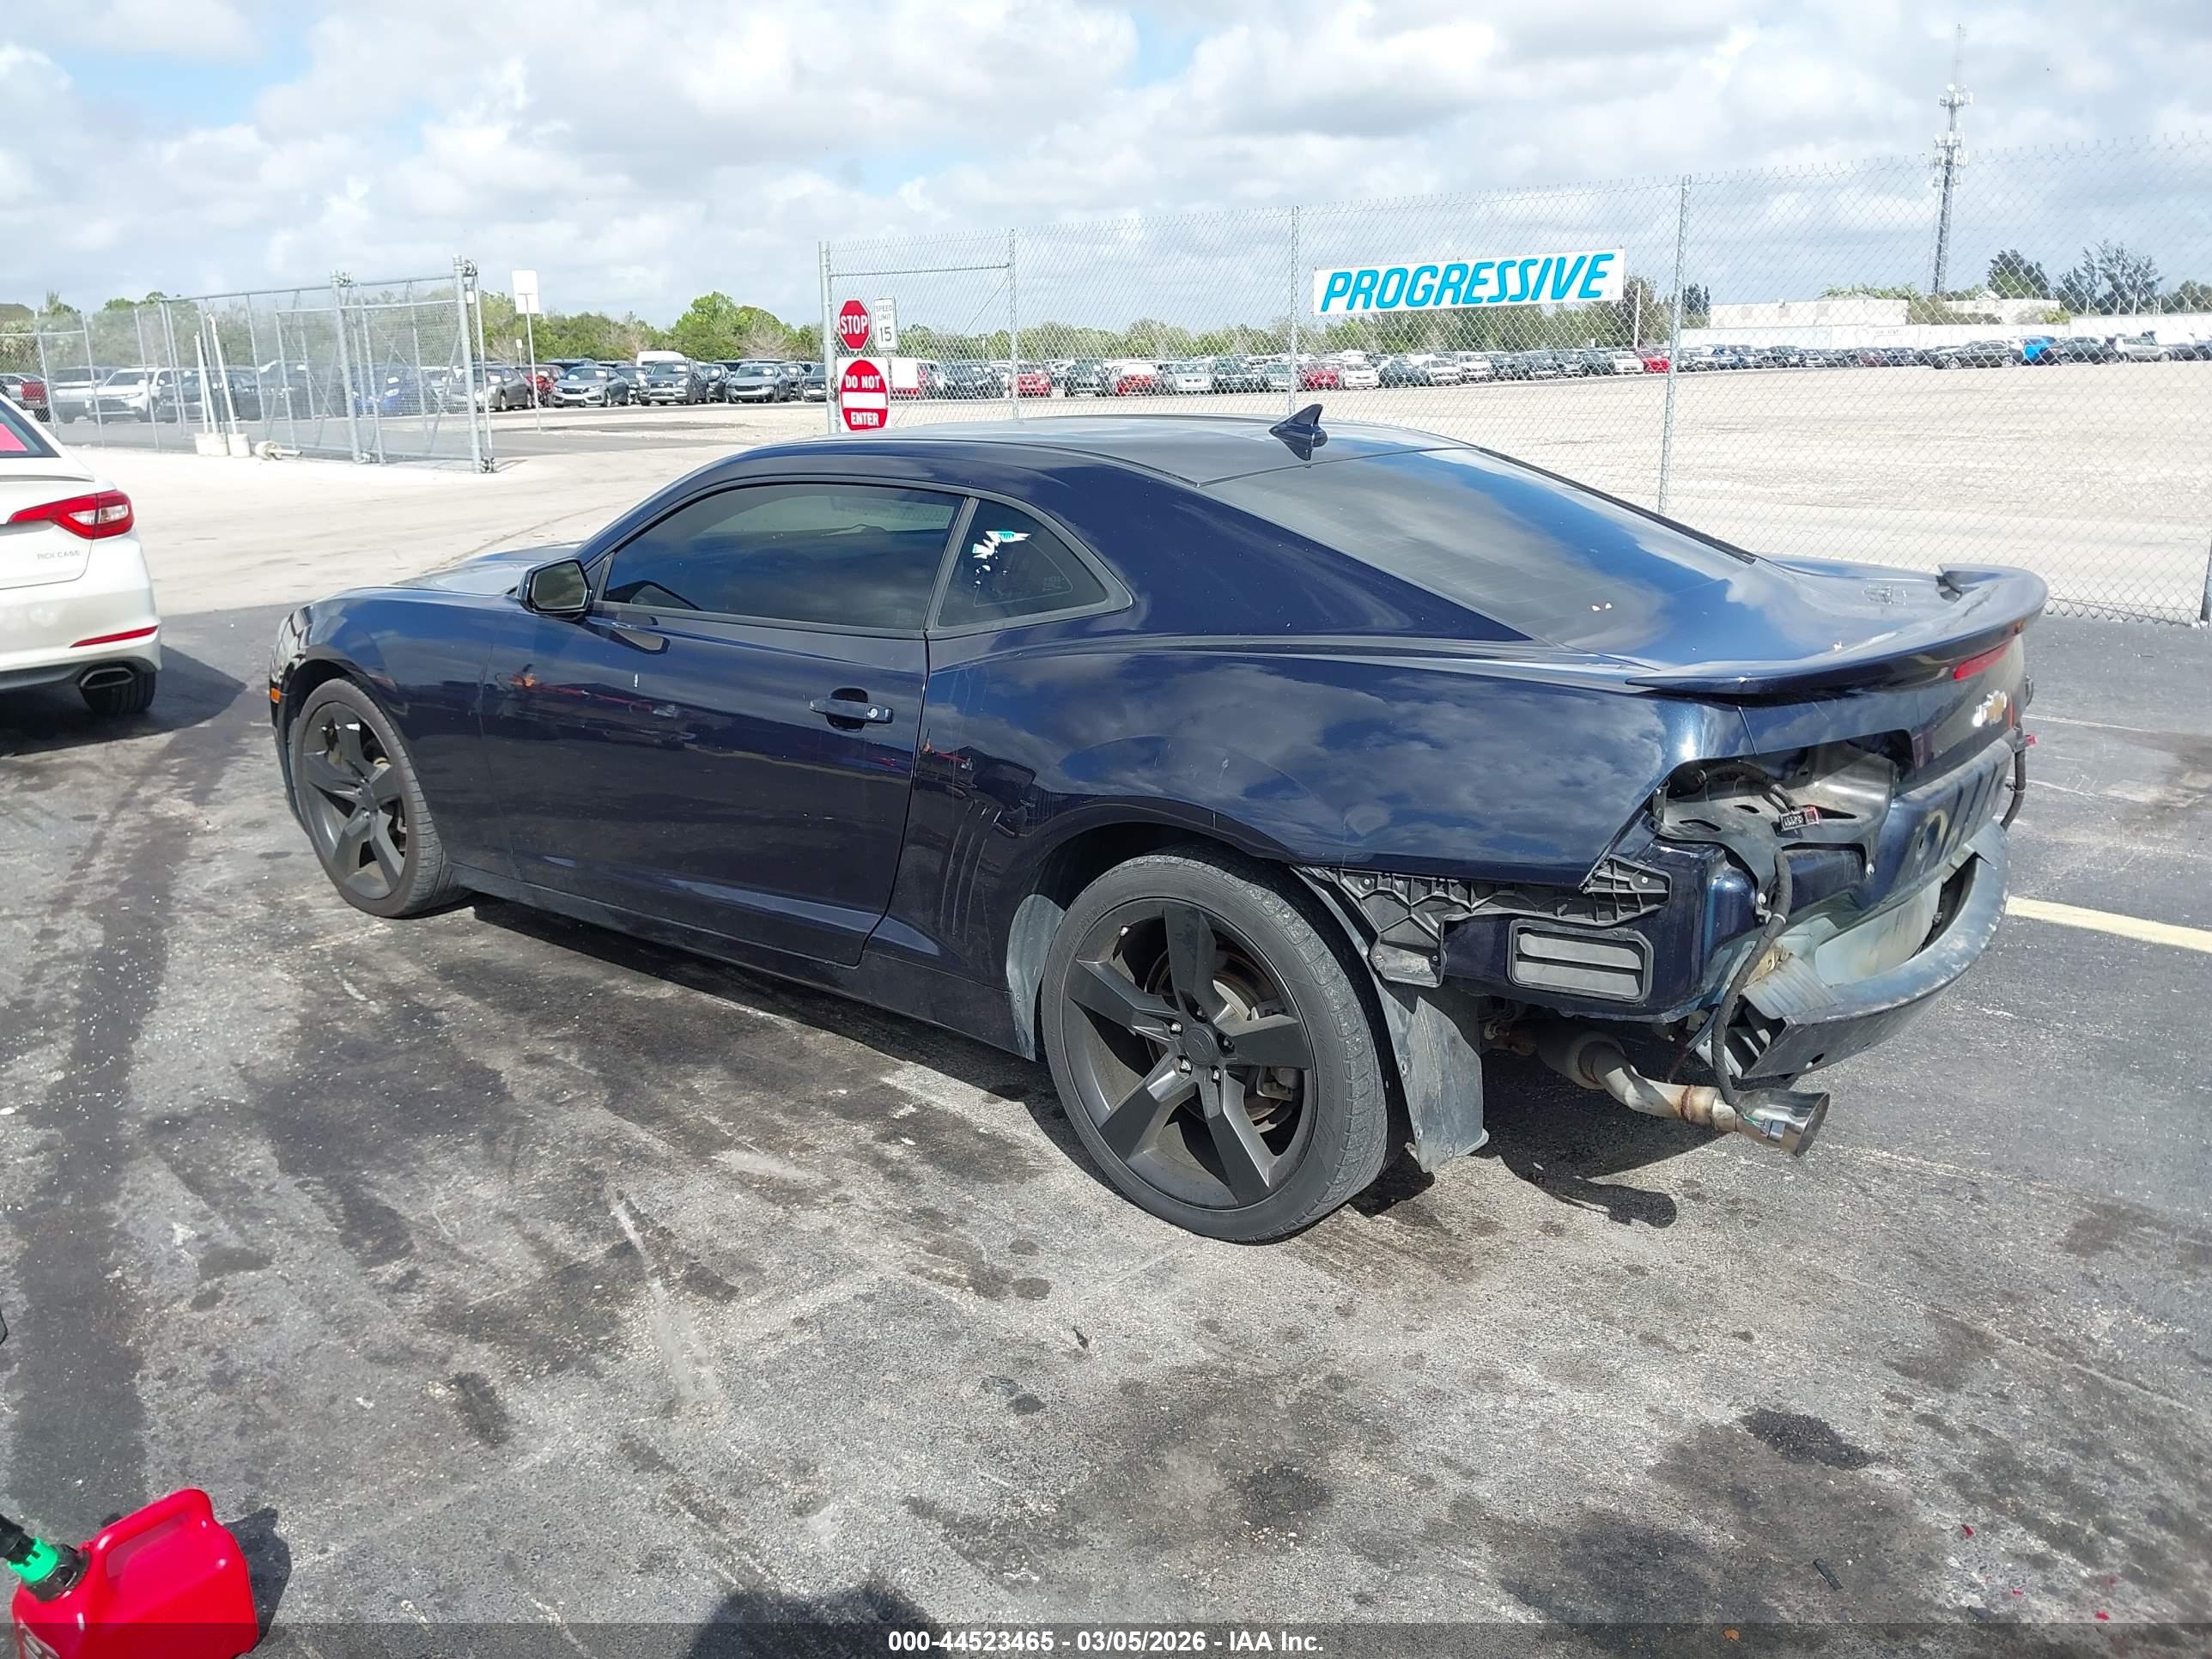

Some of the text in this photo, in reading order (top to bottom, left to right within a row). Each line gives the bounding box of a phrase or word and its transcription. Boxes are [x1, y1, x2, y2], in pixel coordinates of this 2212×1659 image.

[1321, 253, 1615, 313] PROGRESSIVE
[875, 304, 893, 313] SPEED
[840, 314, 868, 335] STOP
[879, 326, 892, 343] 15
[845, 374, 880, 389] DO NOT
[850, 411, 879, 426] ENTER
